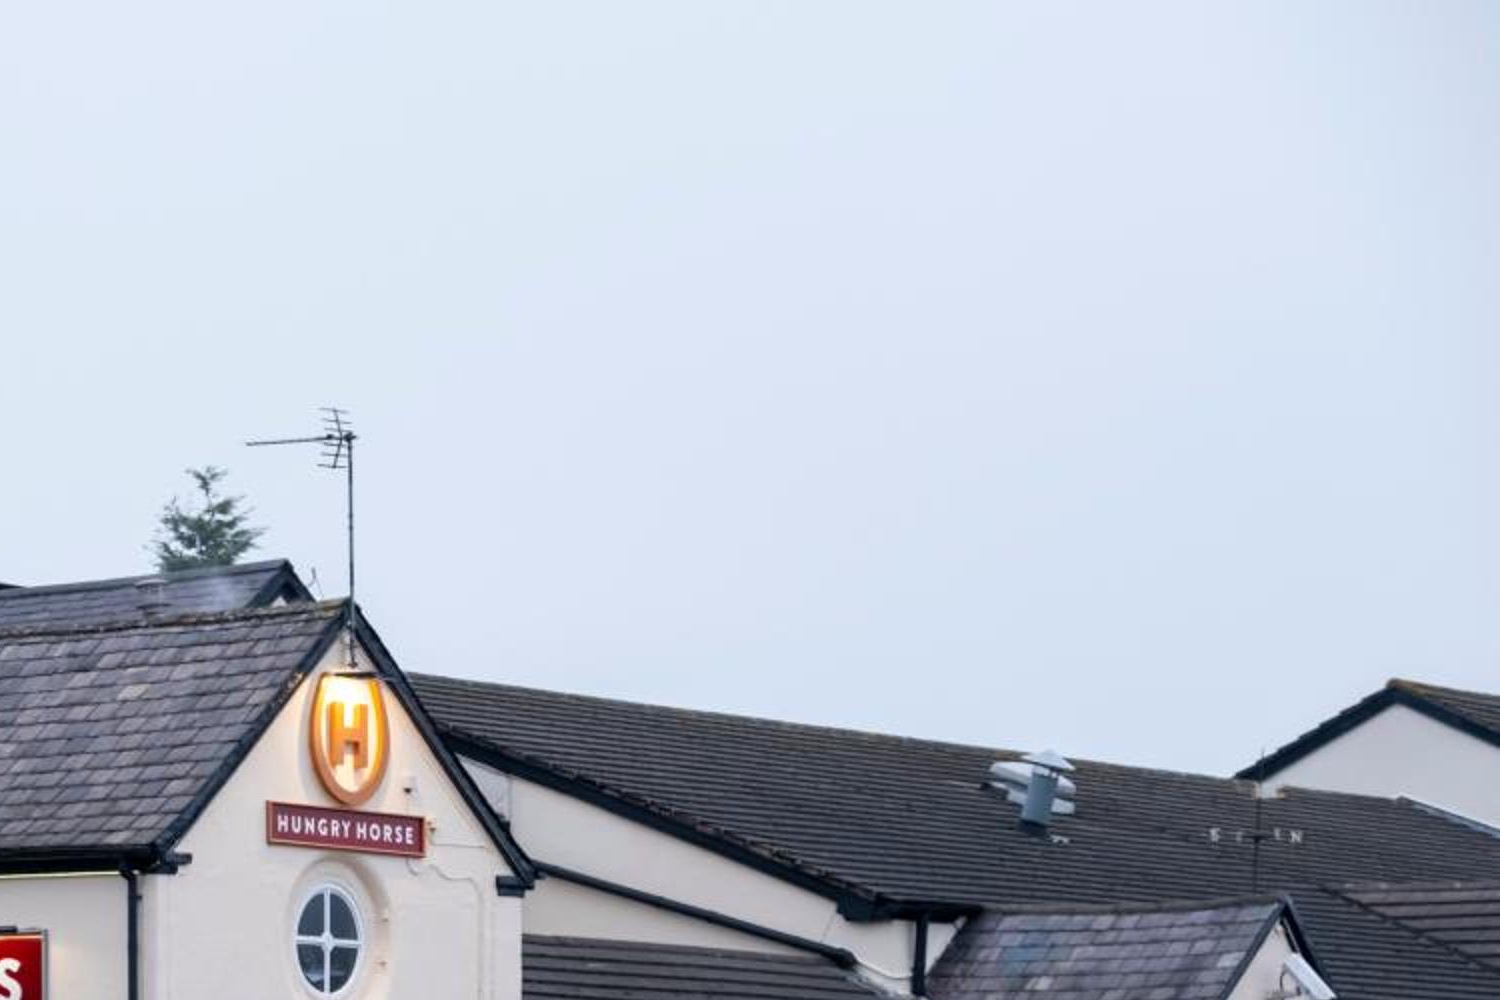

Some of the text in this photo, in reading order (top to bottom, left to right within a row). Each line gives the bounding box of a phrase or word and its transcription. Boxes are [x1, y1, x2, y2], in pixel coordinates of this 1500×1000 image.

[329, 702, 368, 768] H
[276, 814, 414, 844] HUNGRY HORSE
